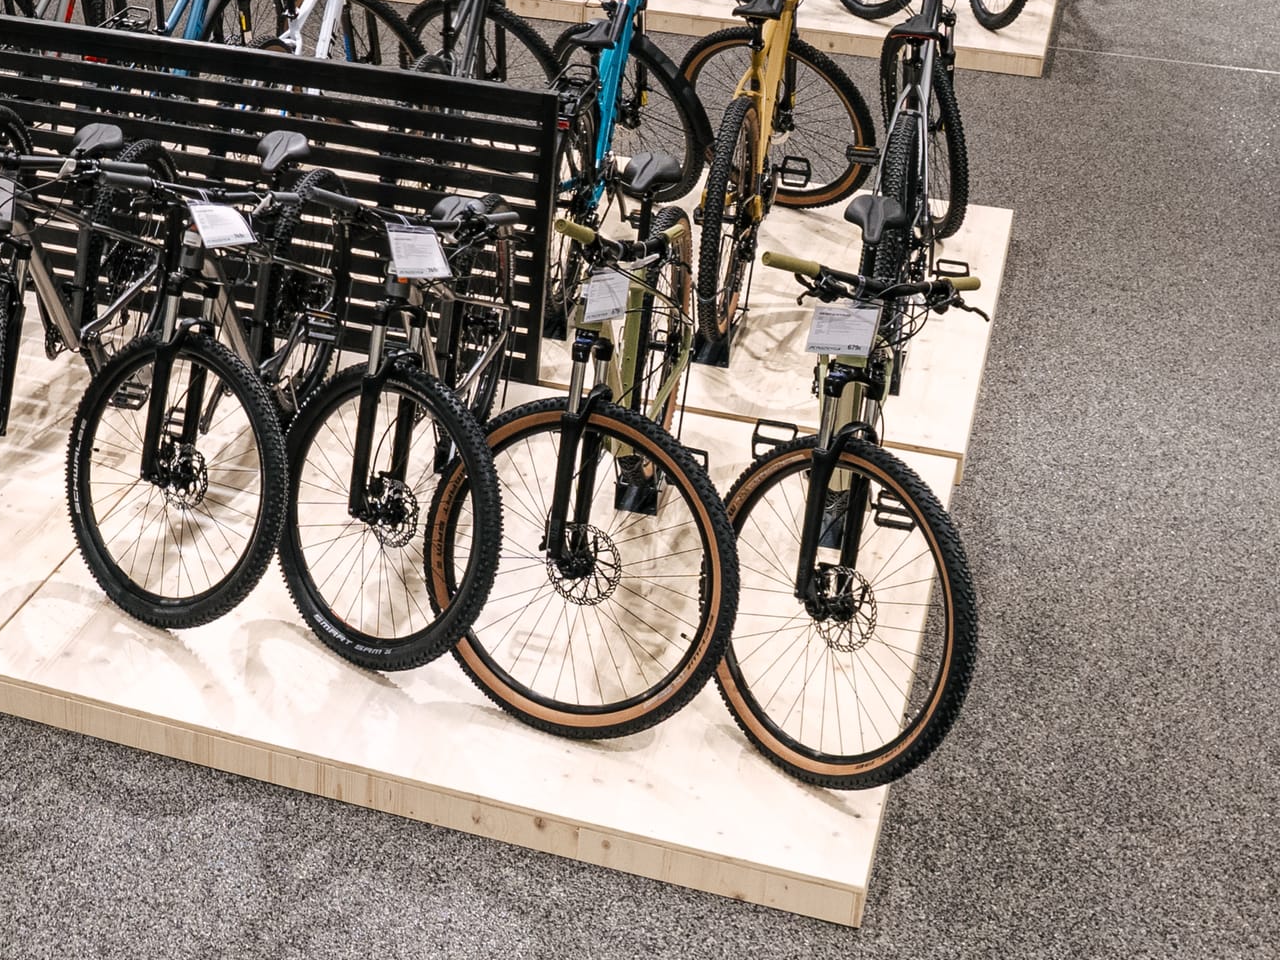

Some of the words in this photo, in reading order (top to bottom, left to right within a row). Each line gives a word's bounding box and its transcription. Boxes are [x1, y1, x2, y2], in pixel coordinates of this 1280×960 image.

[72, 418, 88, 515] SCHWALBE
[313, 613, 353, 646] SMART
[354, 643, 383, 656] SAM
